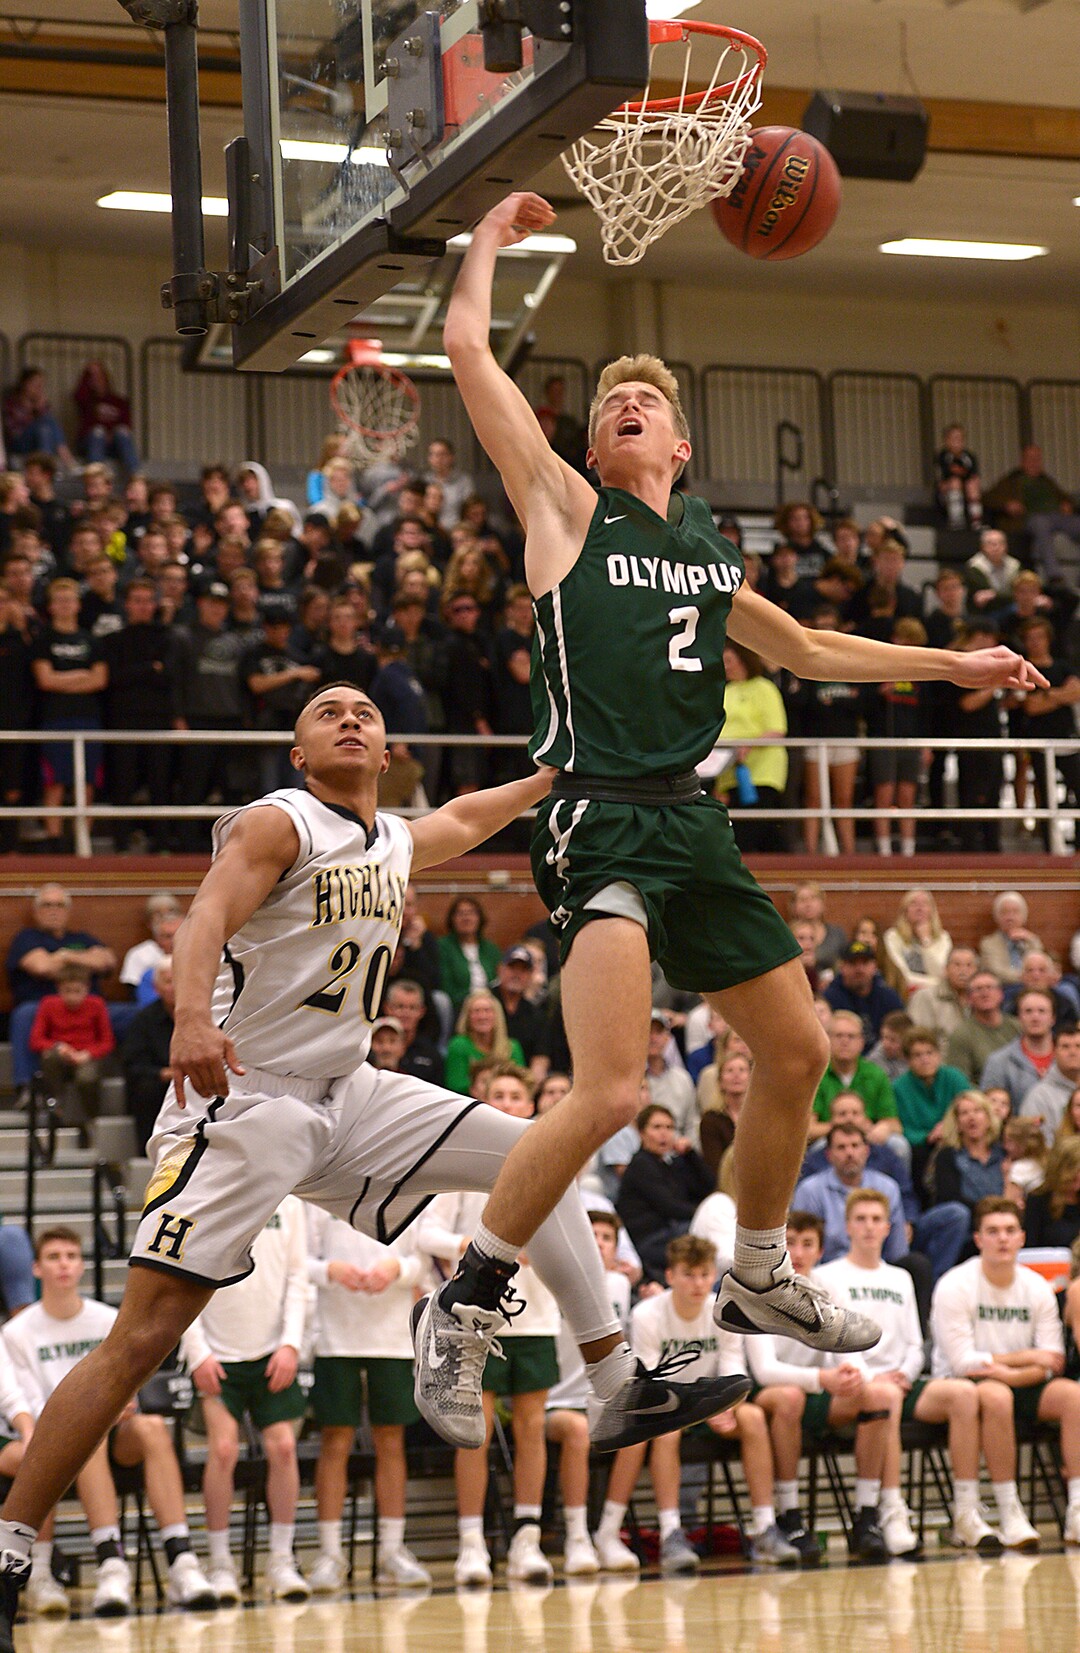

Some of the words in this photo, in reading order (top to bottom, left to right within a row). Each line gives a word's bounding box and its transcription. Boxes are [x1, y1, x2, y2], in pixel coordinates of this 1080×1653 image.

[756, 154, 812, 238] Wilson
[606, 553, 742, 596] OLYMPUS
[667, 605, 703, 672] 2
[297, 938, 393, 1024] 20
[145, 1210, 198, 1264] H
